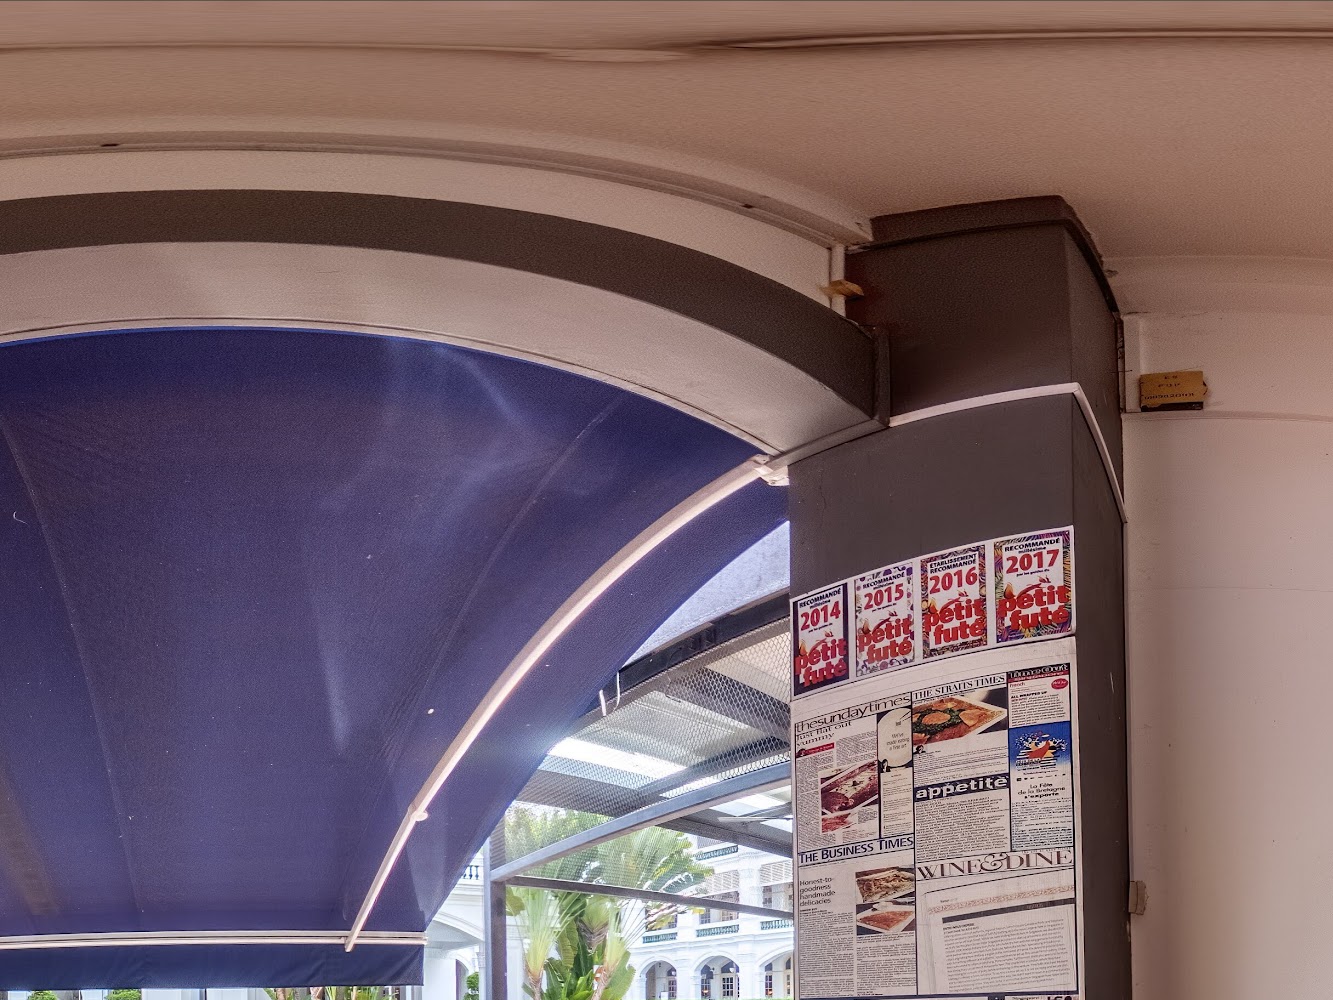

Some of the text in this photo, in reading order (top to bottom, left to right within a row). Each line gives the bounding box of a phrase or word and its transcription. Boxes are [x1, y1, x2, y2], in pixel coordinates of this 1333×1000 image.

[1004, 538, 1061, 552] RECOMMANDÉ
[1006, 549, 1060, 574] 2017
[930, 566, 978, 595] 2016
[864, 583, 905, 610] 2015
[998, 583, 1071, 618] petit
[800, 601, 841, 631] 2014
[923, 597, 986, 632] petit
[1010, 605, 1070, 630] futé
[857, 616, 913, 652] petit
[933, 617, 985, 646] futé
[794, 638, 847, 675] petit
[867, 636, 913, 664] futé
[803, 657, 847, 687] futé
[913, 675, 1005, 700] THE STRAITS TIMES
[796, 694, 911, 733] thesundaytimes
[915, 776, 1008, 800] appetite
[799, 836, 914, 863] THE BUSINESS TIMES
[917, 850, 1073, 881] WINE&DINE
